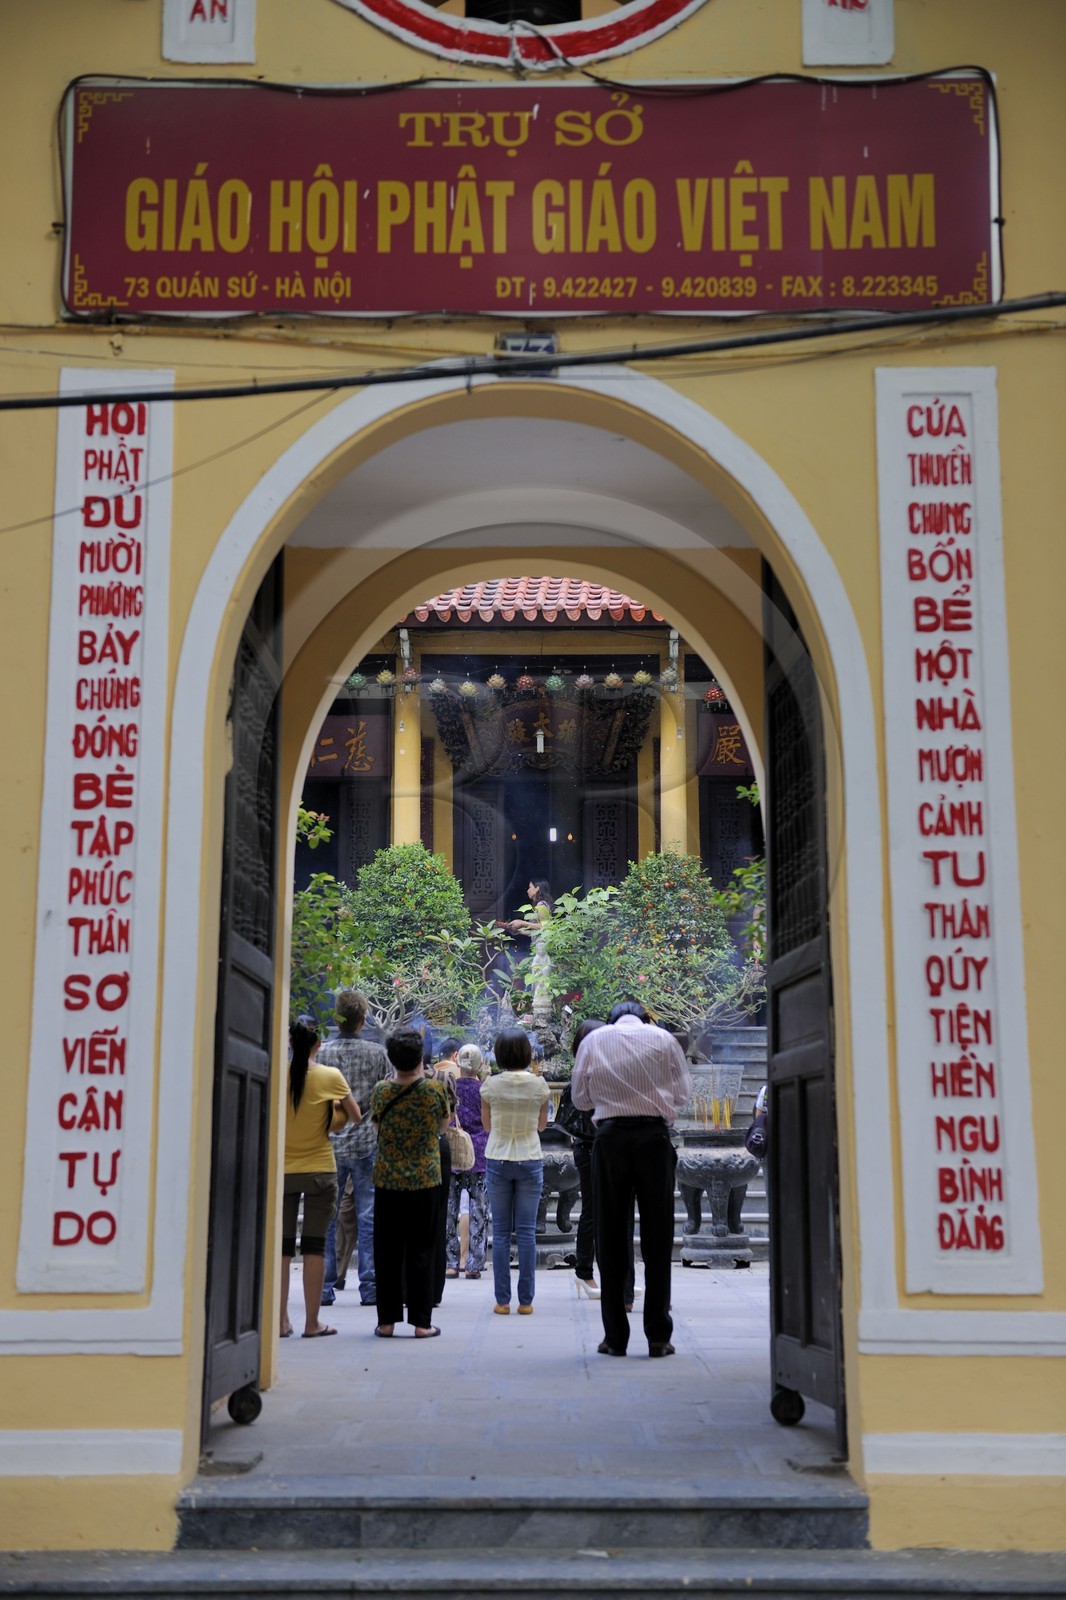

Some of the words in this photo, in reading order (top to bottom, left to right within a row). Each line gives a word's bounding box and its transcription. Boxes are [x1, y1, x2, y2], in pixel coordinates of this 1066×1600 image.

[399, 111, 534, 157] TRỤ
[554, 92, 644, 147] SỞ
[125, 162, 251, 254] GIÁO
[268, 163, 358, 269] HỘI
[377, 164, 515, 269] PHẬT
[532, 162, 657, 254] GIÁO
[675, 160, 789, 267] VIỆT
[809, 173, 936, 250] NAM
[124, 277, 149, 298] 73
[156, 271, 219, 299] QUÁN
[227, 270, 258, 298] SỨ
[275, 271, 306, 298] HÀ
[313, 271, 352, 304] NỘI
[496, 277, 525, 298] ĐT
[543, 277, 638, 298] 9.422427
[661, 277, 758, 298] 9.420839
[781, 276, 823, 297] FAX
[842, 276, 939, 297] 8.223345
[84, 443, 144, 485] PHẬT
[82, 484, 142, 530] ĐỦ
[908, 502, 972, 535] CHUNG
[79, 532, 142, 575] MƯỜI
[908, 537, 973, 583] BỐN
[79, 581, 143, 618] PHƯƠNG
[914, 583, 973, 633] BỂ
[78, 622, 140, 666] BẢY
[915, 639, 972, 686] MỘT
[76, 668, 141, 711] CHÚNG
[916, 687, 982, 732] NHÀ
[72, 714, 139, 759] ĐÓNG
[73, 764, 135, 811] BÈ
[918, 744, 983, 788] MƯỢN
[918, 794, 984, 837] CẢNH
[69, 860, 133, 906] PHÚC
[922, 850, 986, 888] TU
[68, 908, 131, 956] THÂN
[64, 971, 130, 1012] SƠ
[930, 1002, 993, 1051] TIỆN
[63, 1026, 127, 1075] VIỄN
[931, 1052, 996, 1098] HIỀN
[58, 1086, 124, 1132] CẬN
[935, 1115, 1000, 1153] NGU
[59, 1150, 121, 1196] TỰ
[938, 1157, 1004, 1204] BÌNH
[53, 1211, 117, 1247] DO
